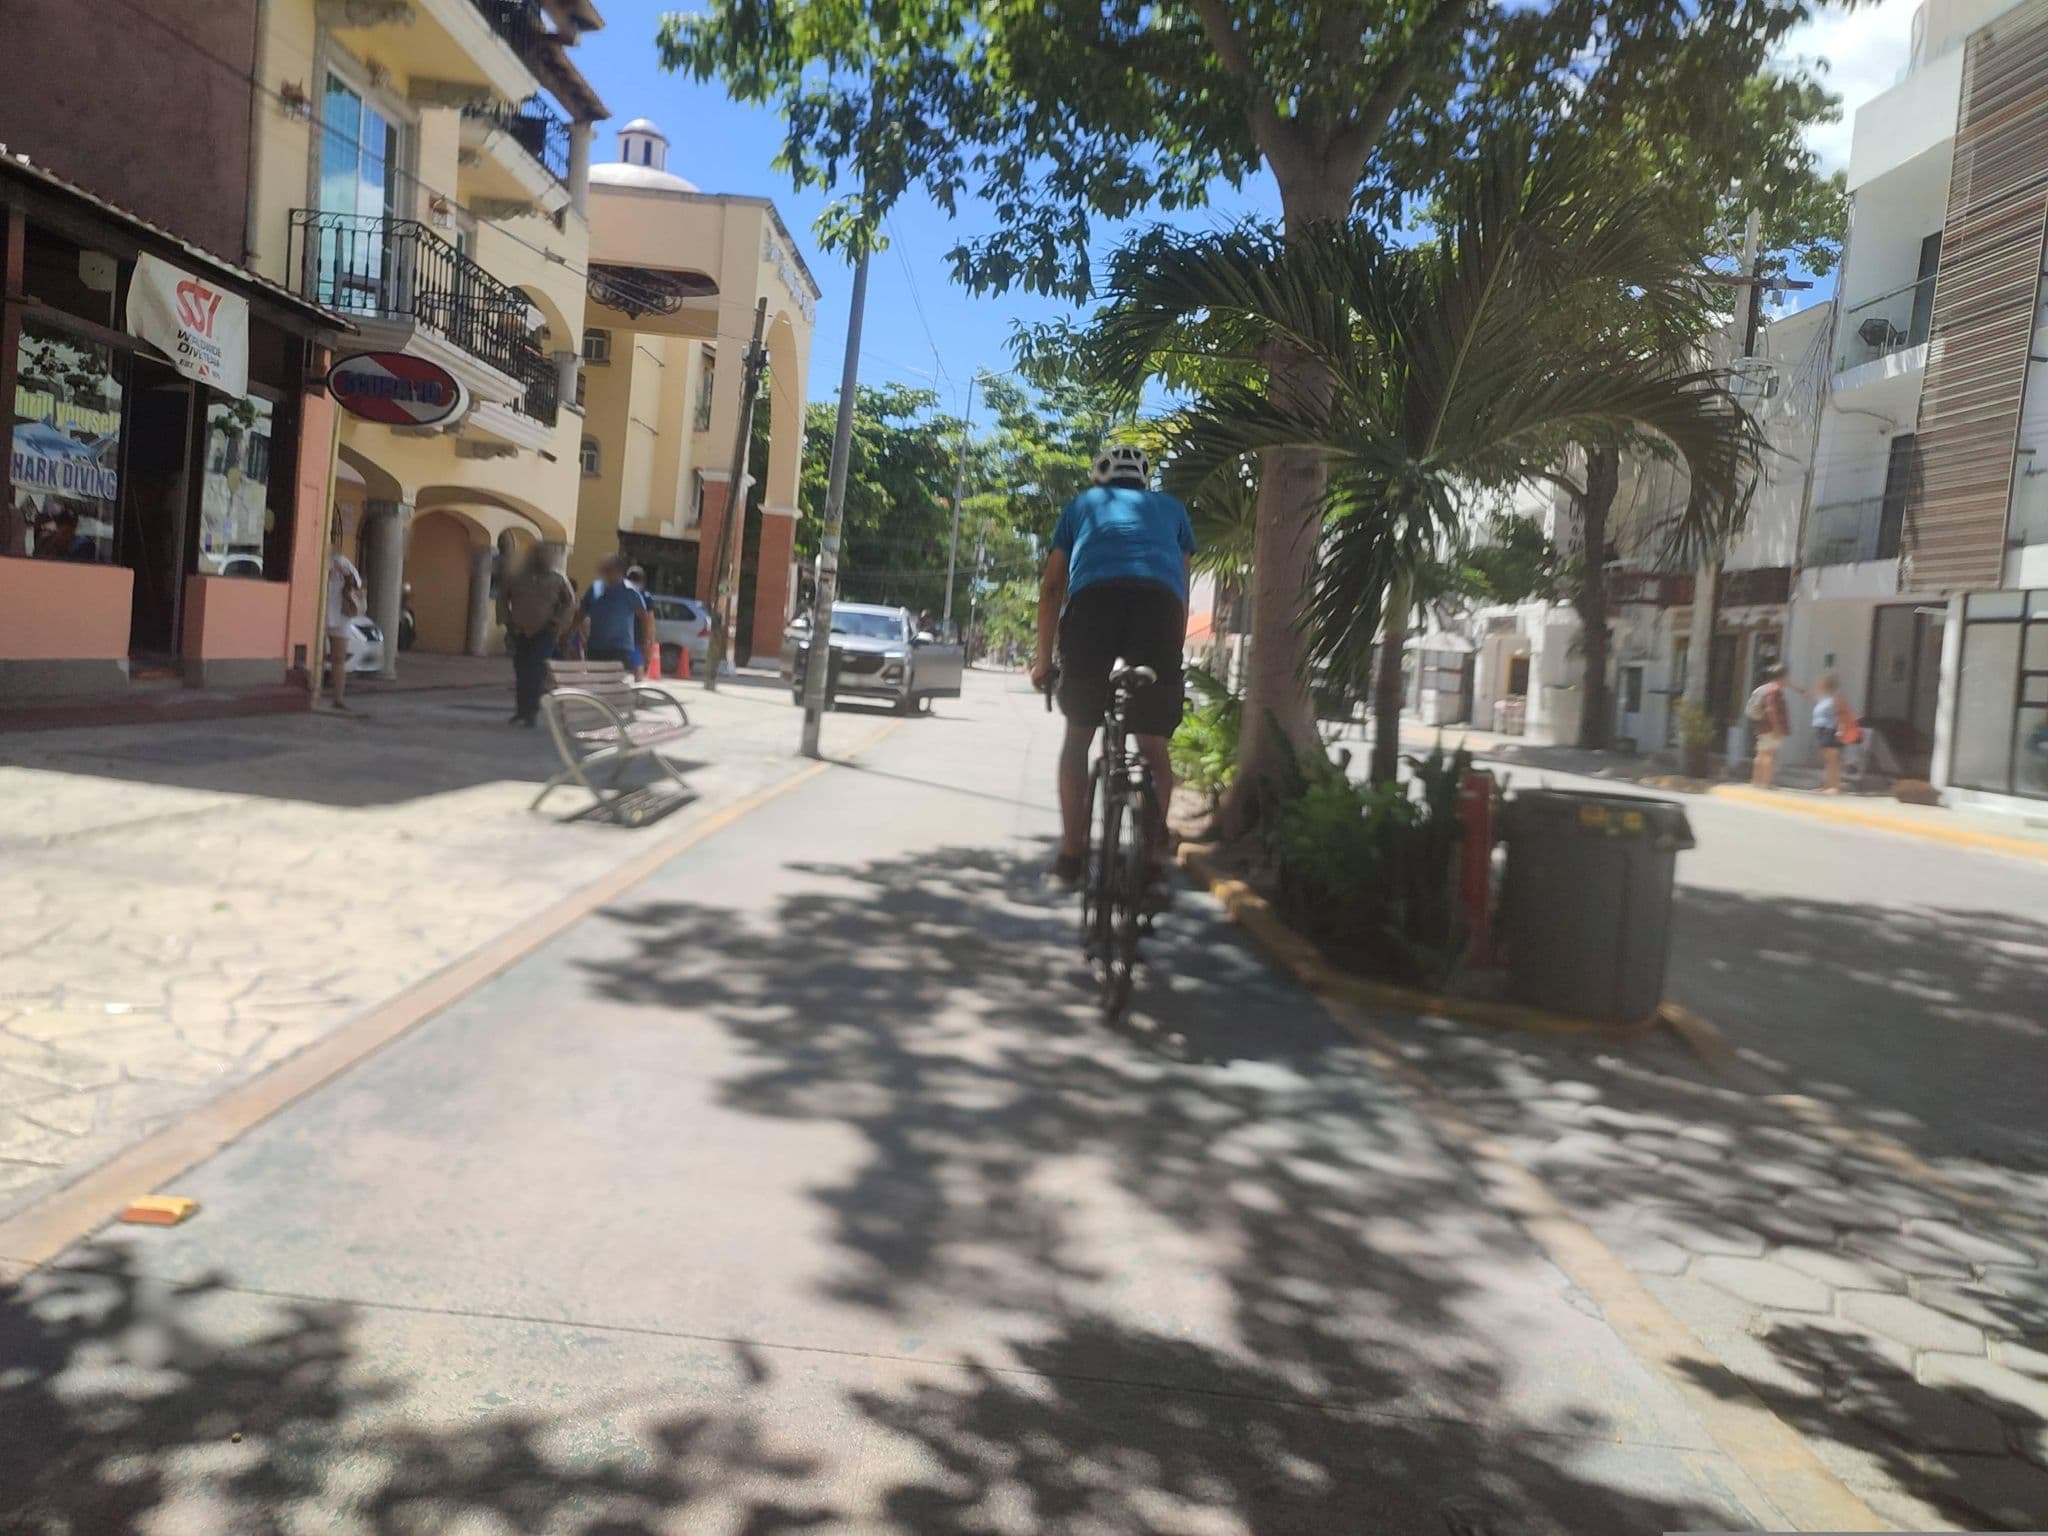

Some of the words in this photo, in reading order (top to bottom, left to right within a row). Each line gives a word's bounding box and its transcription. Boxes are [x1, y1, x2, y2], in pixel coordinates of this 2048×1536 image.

[176, 281, 222, 338] SSI
[12, 453, 59, 486] HARK
[62, 462, 117, 500] DIVING
